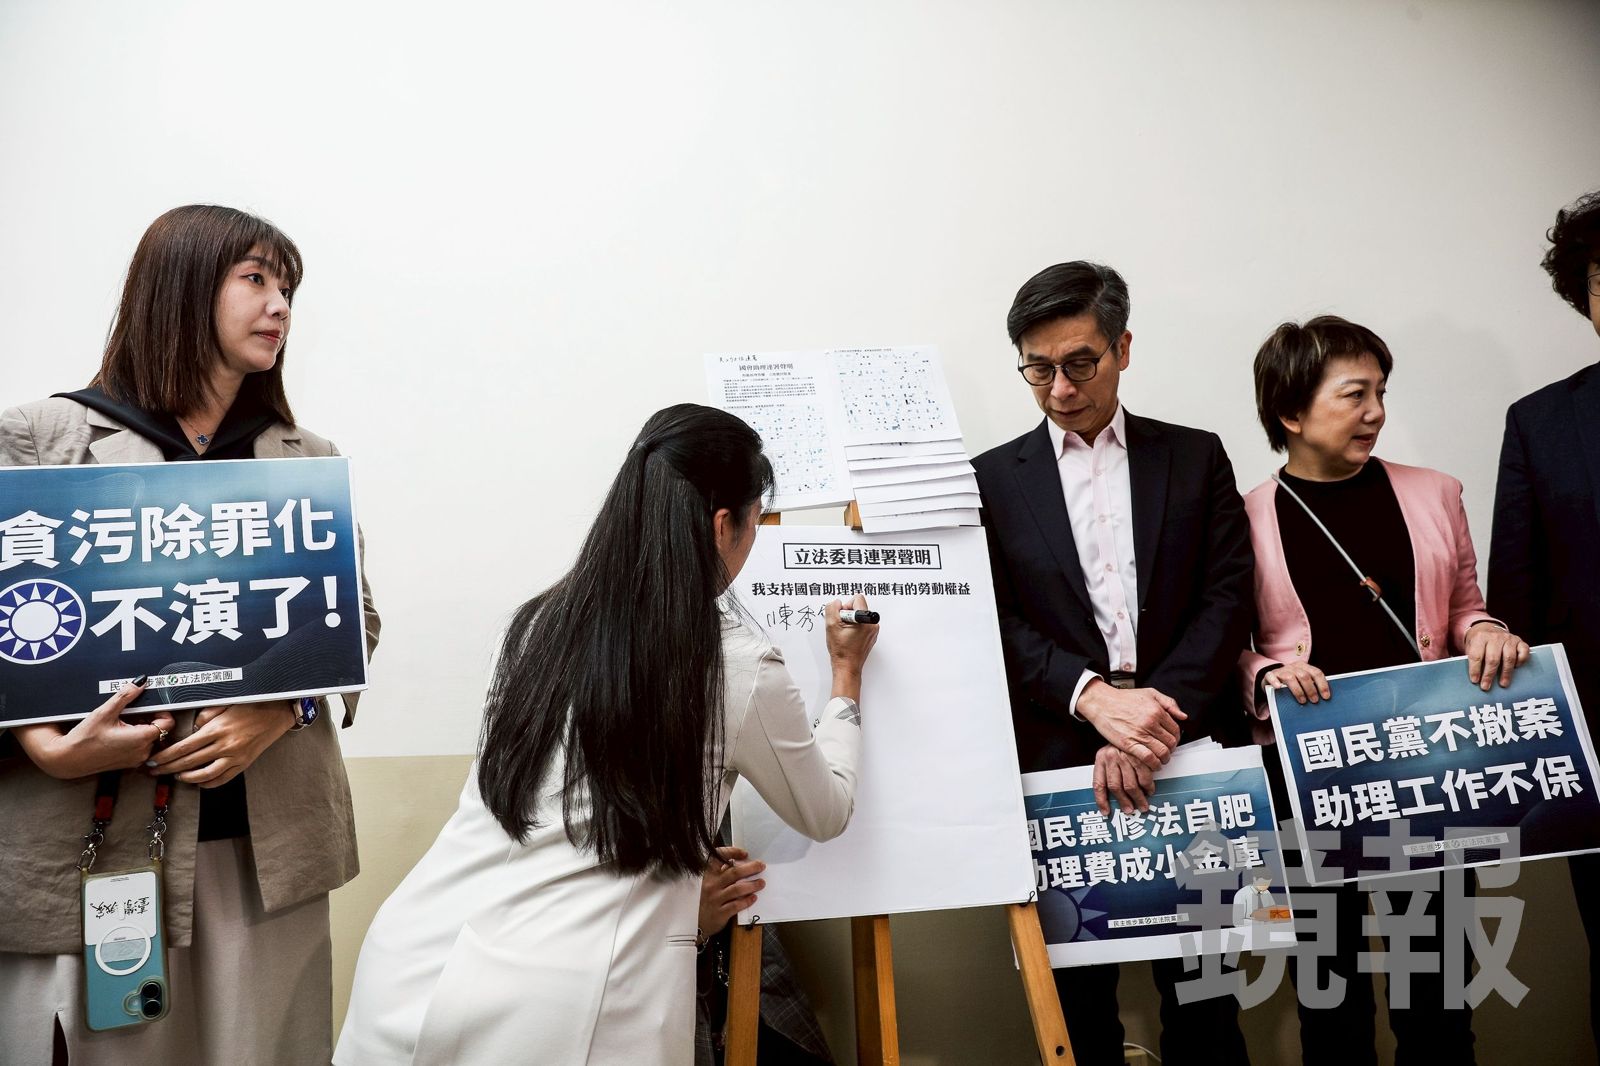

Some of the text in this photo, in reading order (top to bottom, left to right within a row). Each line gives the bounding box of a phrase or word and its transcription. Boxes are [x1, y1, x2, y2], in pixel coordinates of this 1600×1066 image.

[0, 498, 337, 570] 貪污除罪化
[794, 548, 932, 565] 立法委員連署聲明
[751, 582, 971, 596] 我支持國會助理捍衛應有的勞動權益
[110, 671, 233, 692] 民步黨 立法院黨團
[1296, 697, 1564, 773] 國民黨不撤案
[1311, 755, 1584, 828] 助理工作不保
